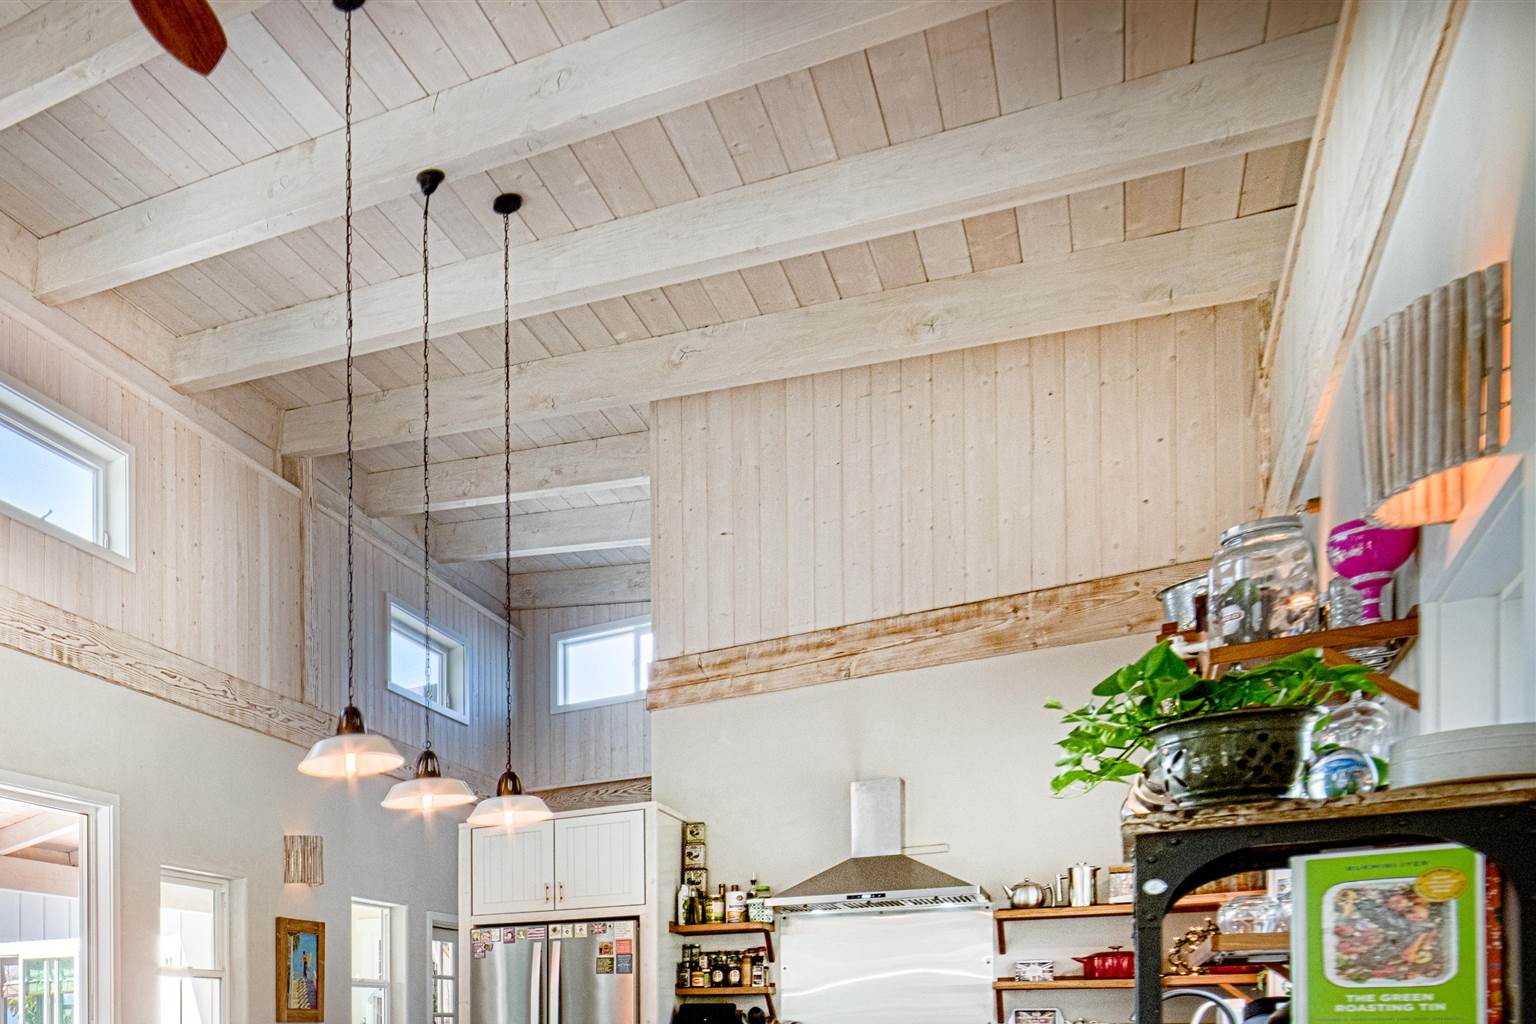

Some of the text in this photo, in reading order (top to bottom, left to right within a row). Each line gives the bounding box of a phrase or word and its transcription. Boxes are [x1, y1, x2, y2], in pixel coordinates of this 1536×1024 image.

[1345, 993, 1435, 1002] THE GREEN
[1334, 1003, 1447, 1012] ROASTING TIN
